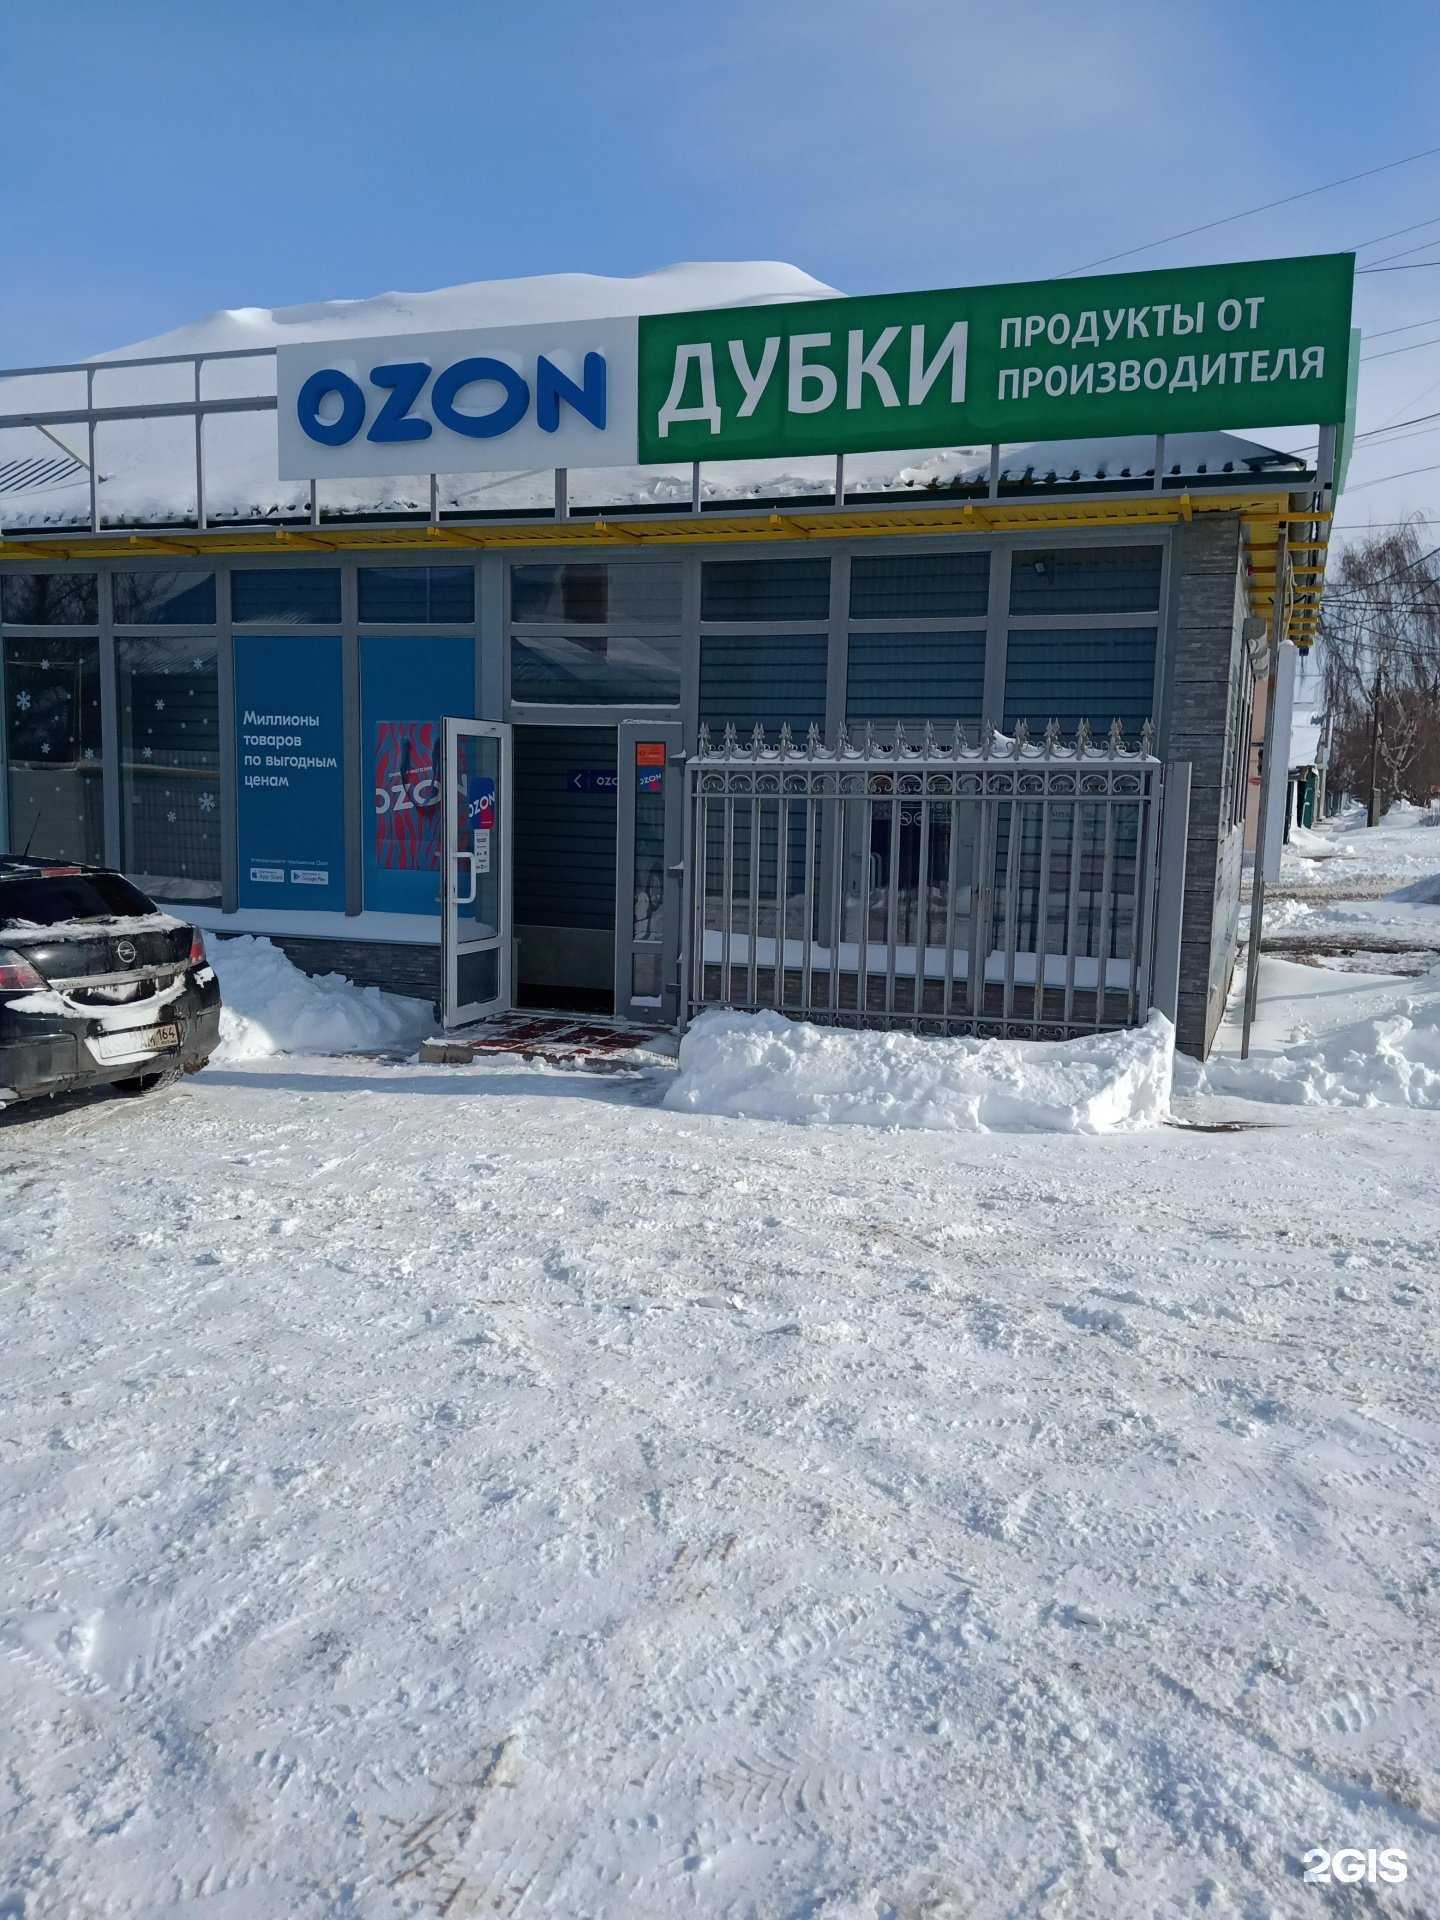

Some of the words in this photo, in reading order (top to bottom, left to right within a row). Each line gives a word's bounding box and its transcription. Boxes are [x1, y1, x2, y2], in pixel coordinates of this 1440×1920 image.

[1000, 302, 1205, 349] ПРОДУКТЫ
[1217, 296, 1265, 332] ОТ
[657, 320, 969, 438] ДУБКИ
[997, 346, 1325, 400] ПРОИЗВОДИТЕЛЯ
[297, 351, 607, 447] OZON
[243, 710, 320, 727] Миллионы
[243, 735, 302, 749] товаров
[244, 755, 262, 767] по
[265, 756, 337, 770] выгодным
[244, 775, 289, 788] ценам
[156, 1026, 175, 1041] 164
